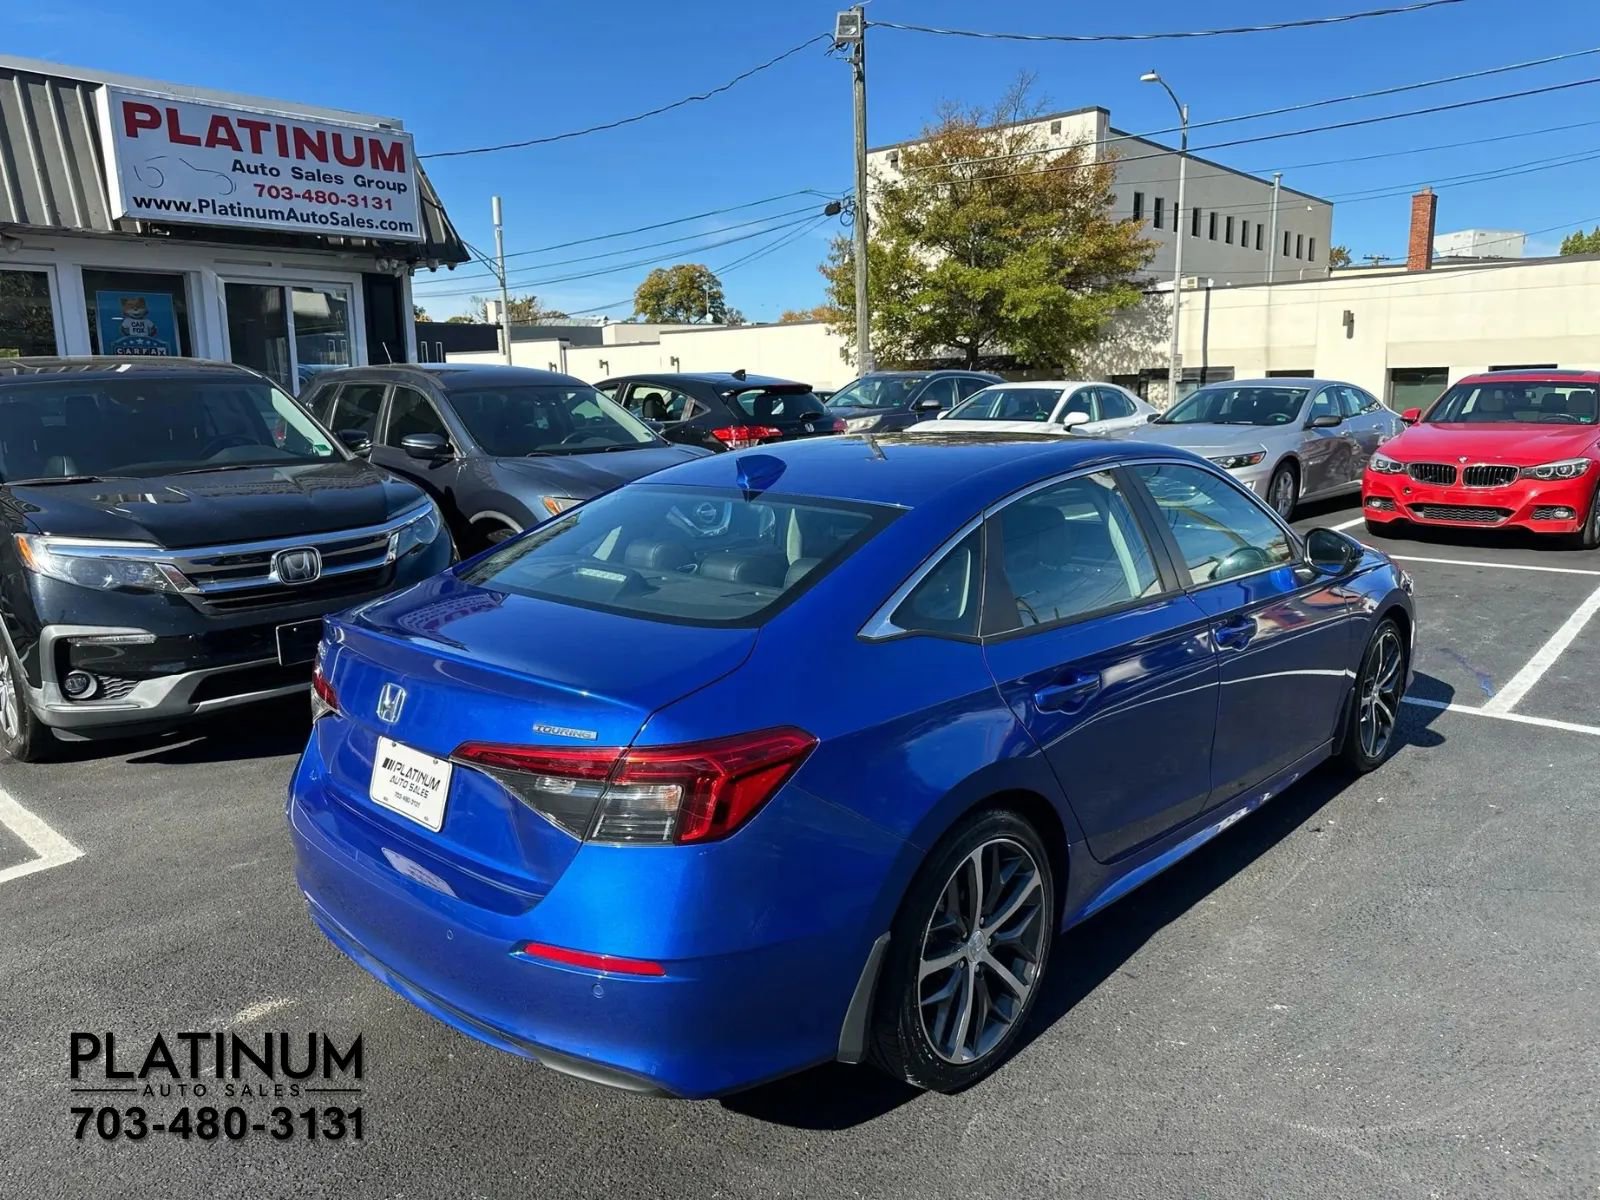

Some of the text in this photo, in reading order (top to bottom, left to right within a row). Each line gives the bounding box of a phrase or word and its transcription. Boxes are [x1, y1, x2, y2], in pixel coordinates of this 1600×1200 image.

[122, 101, 406, 173] PLATINUM
[231, 159, 408, 194] Auto Sales Group
[253, 184, 393, 211] 703-480-3131
[133, 196, 414, 233] www.PlatinumAutoSales.com
[116, 348, 166, 356] CARFAX
[536, 725, 592, 739] TOURING
[389, 775, 430, 799] AUTO SALES
[393, 761, 441, 792] PLATINUM
